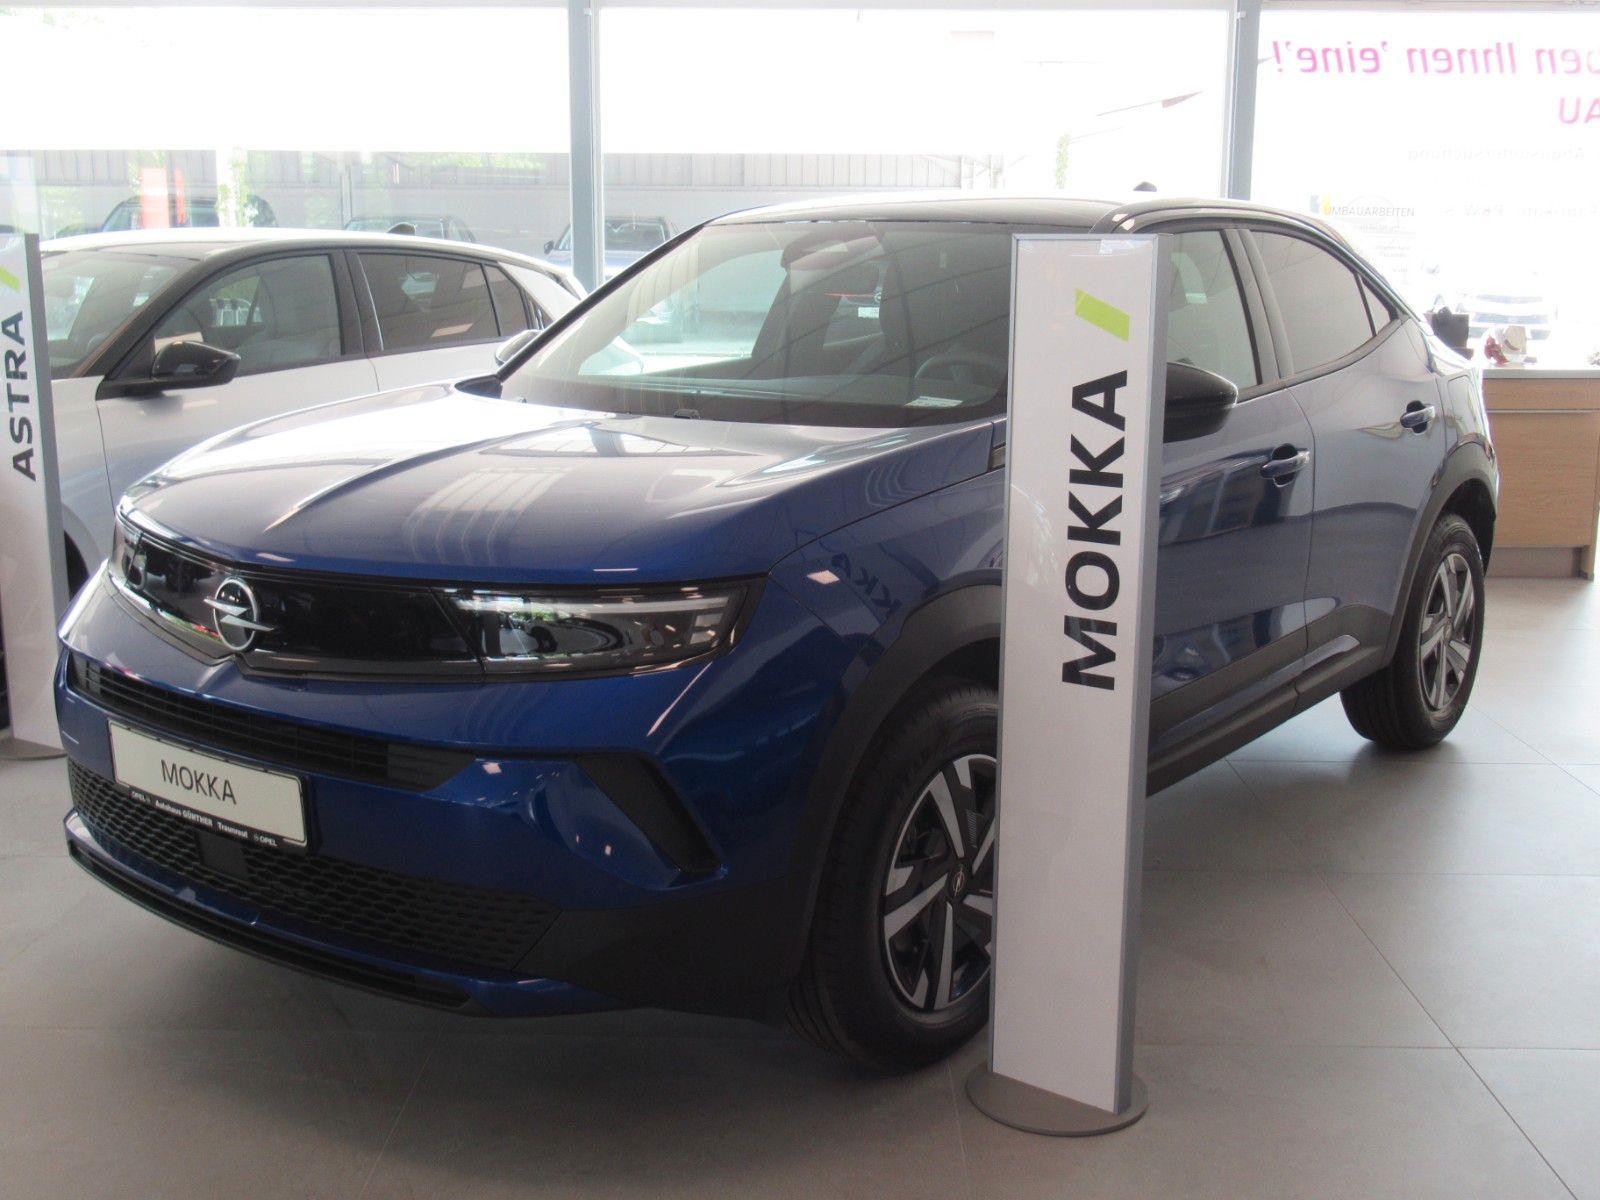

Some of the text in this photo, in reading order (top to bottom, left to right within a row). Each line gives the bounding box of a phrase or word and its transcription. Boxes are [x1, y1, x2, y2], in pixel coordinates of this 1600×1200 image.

[1324, 206, 1415, 217] UMBAUARBEITEN
[1, 311, 37, 482] ASTRA
[1062, 369, 1128, 691] MOKKA
[161, 759, 237, 805] MOKKA
